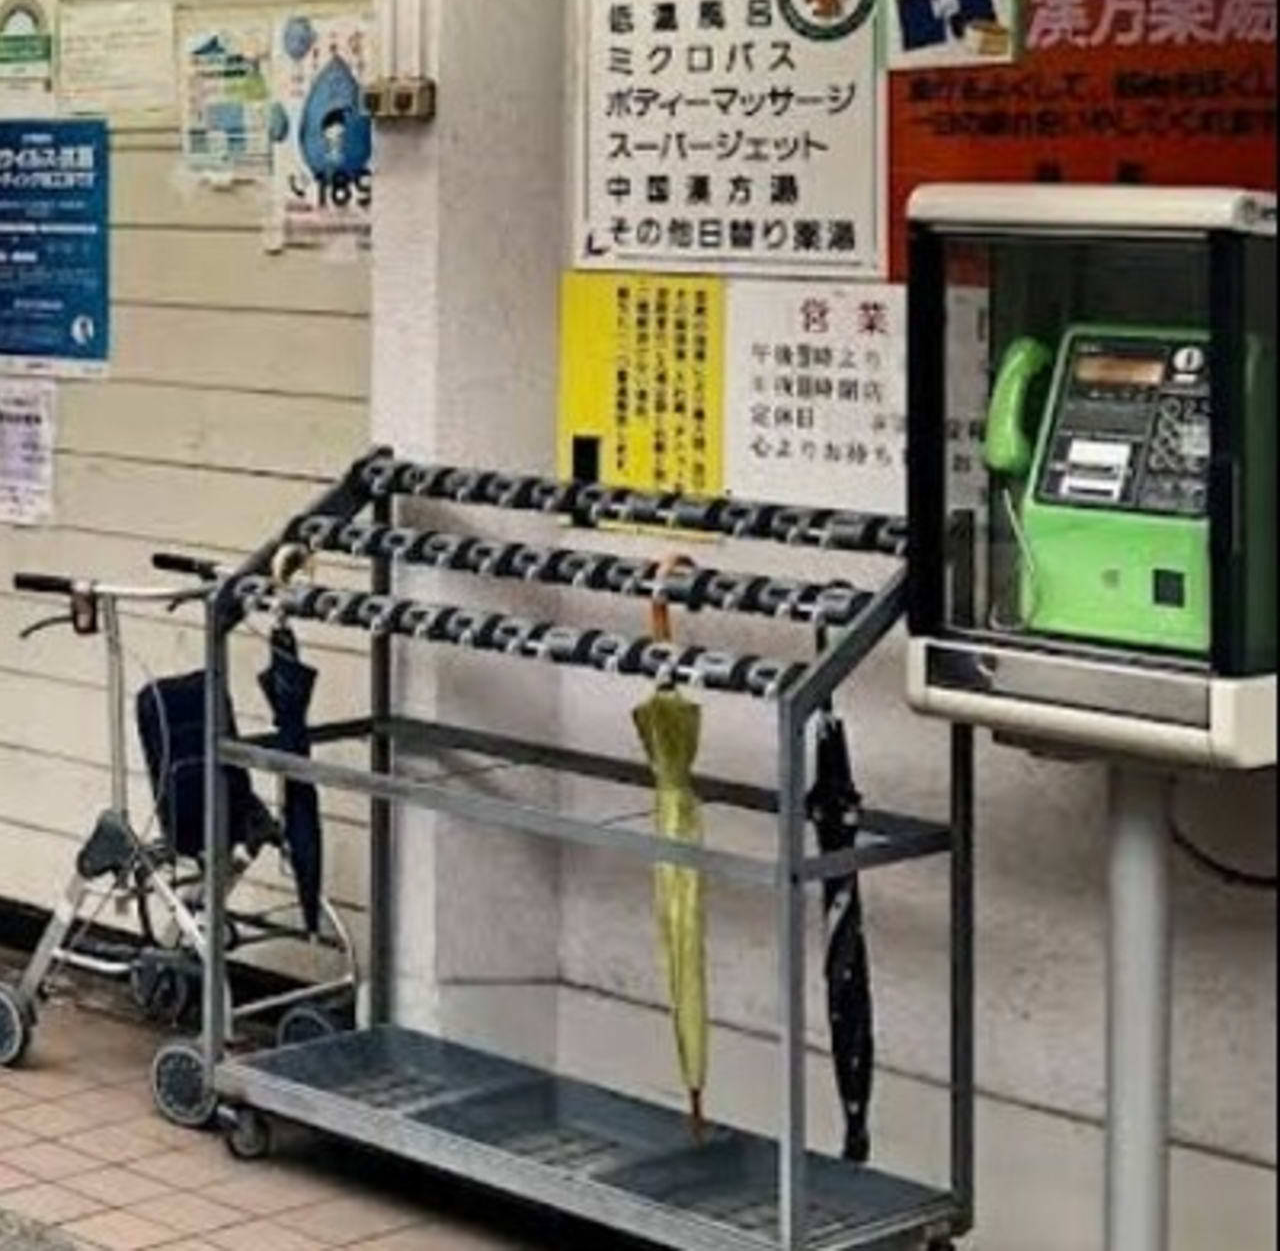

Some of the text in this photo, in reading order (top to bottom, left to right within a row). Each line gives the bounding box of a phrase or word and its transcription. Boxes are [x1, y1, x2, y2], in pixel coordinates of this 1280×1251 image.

[607, 41, 796, 76] ミクロバス
[605, 83, 856, 118] ボディーマッサージ
[608, 129, 831, 161] スーパージェット
